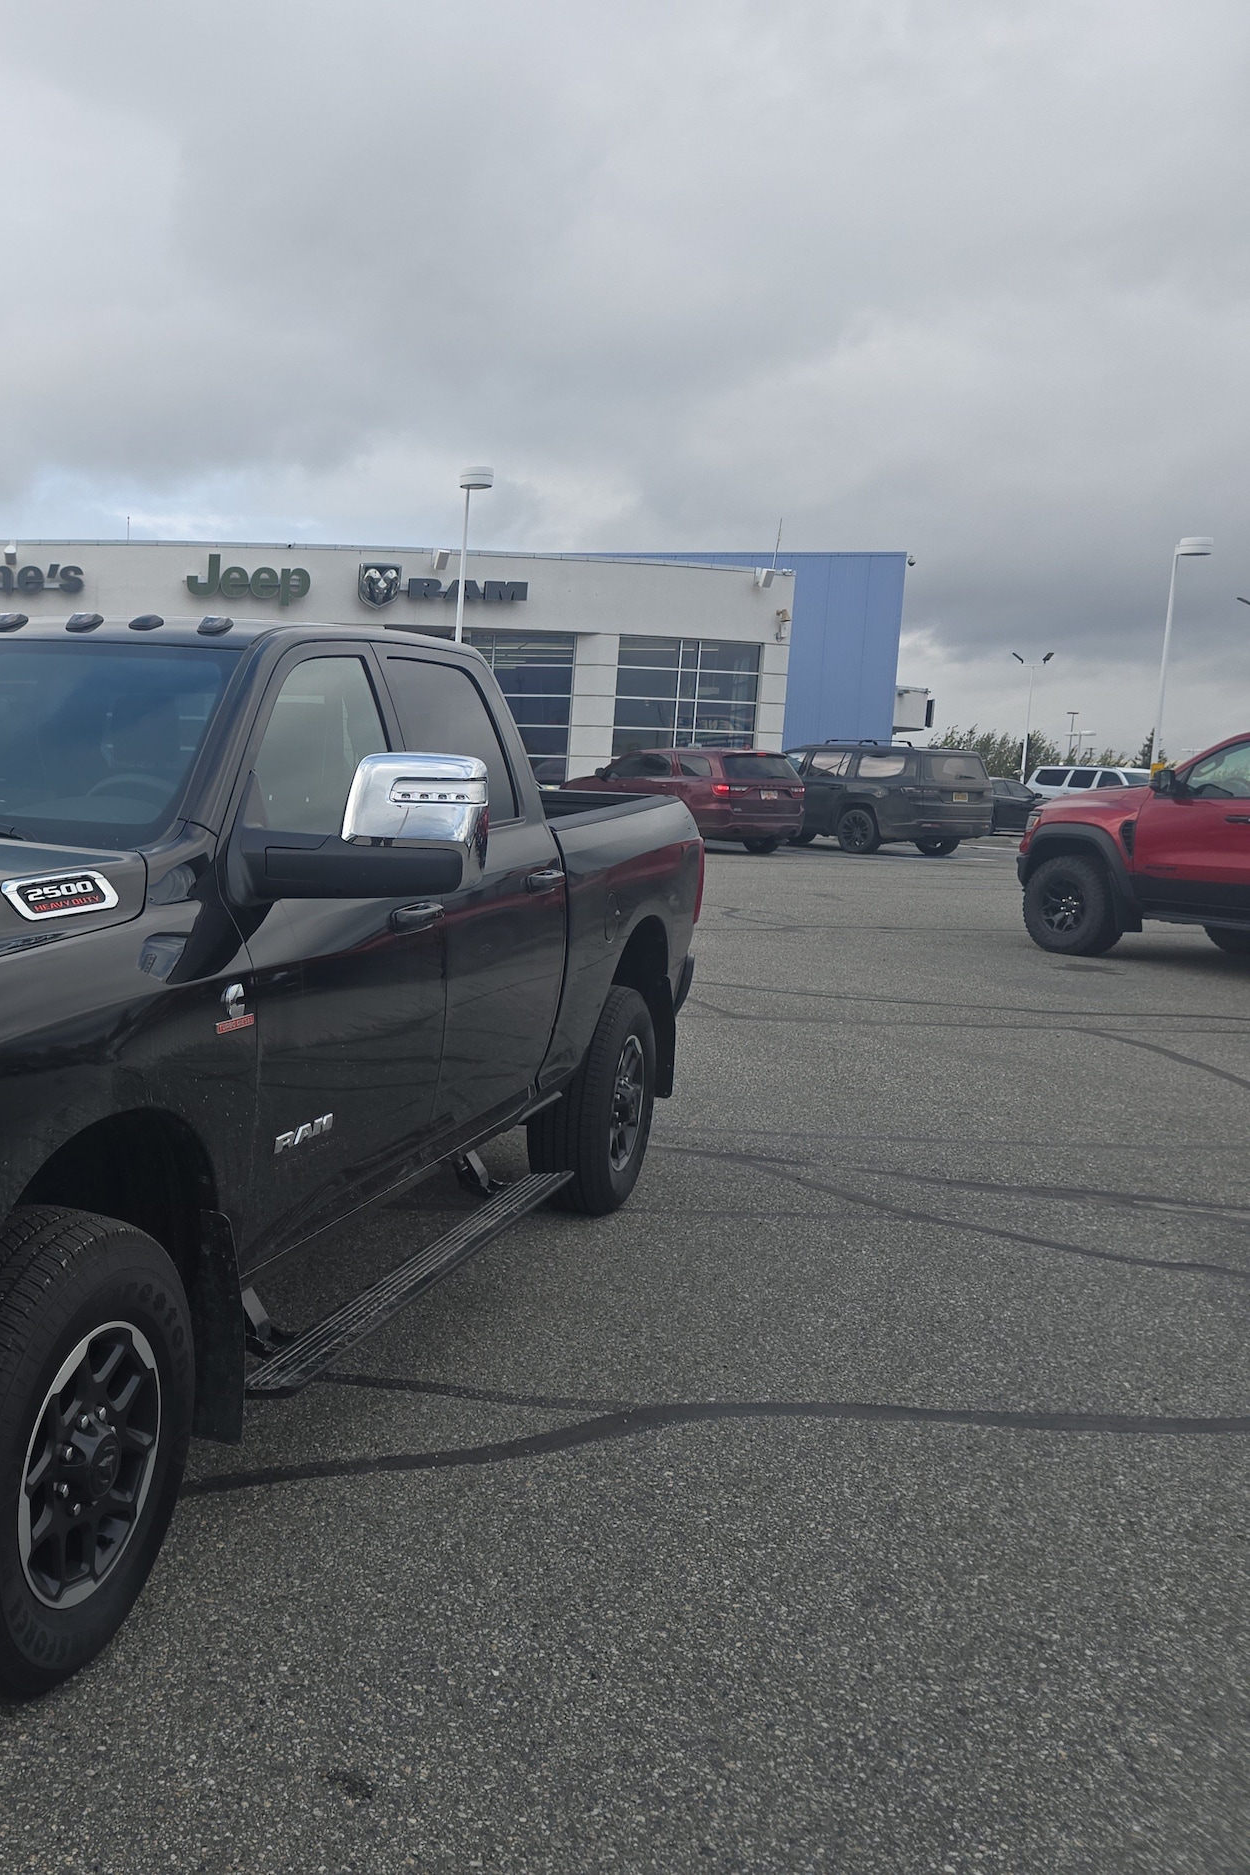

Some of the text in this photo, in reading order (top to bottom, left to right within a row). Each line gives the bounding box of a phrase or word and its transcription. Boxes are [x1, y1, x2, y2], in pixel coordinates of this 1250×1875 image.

[186, 553, 311, 606] Jeep
[407, 577, 528, 601] RAM
[24, 880, 94, 902] 2500
[33, 895, 100, 912] HEAVY DUTY
[273, 1113, 334, 1155] RAM
